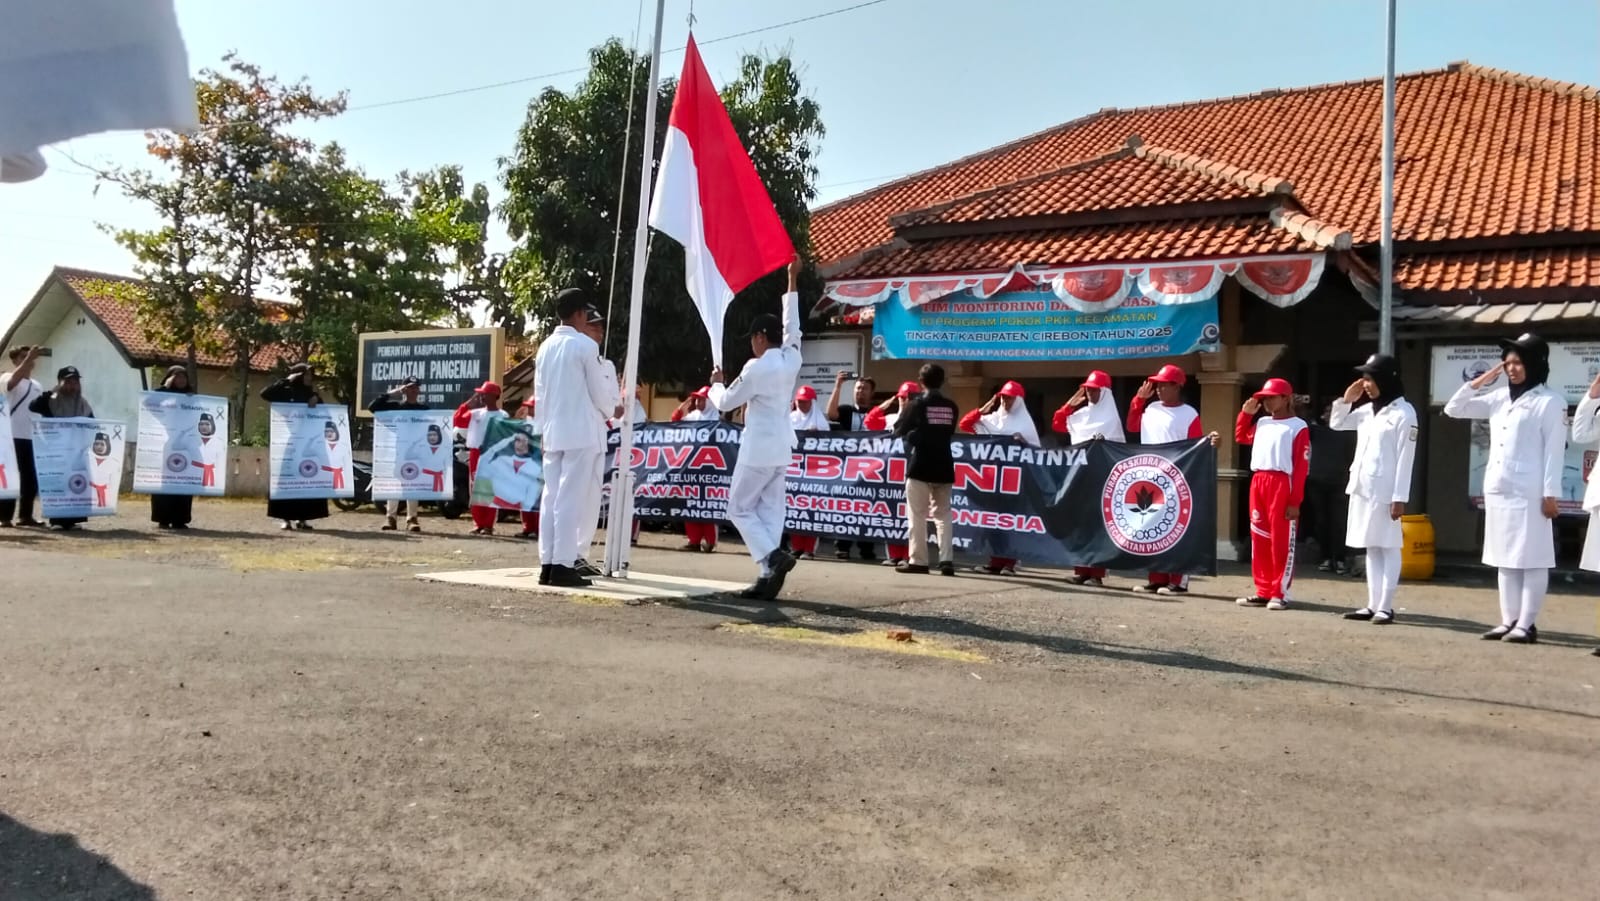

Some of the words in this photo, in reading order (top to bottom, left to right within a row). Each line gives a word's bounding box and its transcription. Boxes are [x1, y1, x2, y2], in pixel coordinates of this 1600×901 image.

[953, 301, 1045, 313] MONITORING
[1050, 302, 1074, 311] DA
[935, 316, 997, 326] PROGRAM
[1000, 316, 1041, 326] POKOK
[1045, 316, 1072, 325] PKK
[904, 330, 957, 341] TINGKAT
[958, 331, 1030, 342] KABUPATEN
[1031, 330, 1089, 342] CIREBON
[1093, 329, 1136, 340] TAHUN
[1138, 326, 1172, 338] 2025
[377, 345, 411, 357] PEMERINTAH
[414, 344, 447, 356] KABUPATEN
[449, 343, 476, 355] CIREBON
[906, 347, 918, 355] DI
[919, 347, 984, 357] KECAMATAN
[985, 348, 1044, 357] PANGENAN
[1047, 345, 1116, 357] KABUPATEN
[1117, 343, 1169, 355] CIREBON
[371, 361, 425, 381] KECAMATAN
[430, 359, 480, 379] PANGENAN
[607, 428, 711, 444] BRKABUNG
[803, 437, 905, 454] BERSAMA
[970, 442, 1089, 465] WAFATNYA
[611, 445, 728, 470] DIVA
[669, 473, 697, 483] TELUK
[800, 482, 829, 494] NATAL
[830, 485, 876, 500] (MADINA)
[1104, 470, 1121, 499] PURNA
[1118, 456, 1159, 474] PASKIBRA
[1158, 461, 1190, 501] INDONESIA
[686, 499, 728, 510] PURN
[785, 520, 860, 536] CIREBON
[1106, 519, 1145, 552] KECAMATAN
[1146, 522, 1185, 553] PANGENAN
